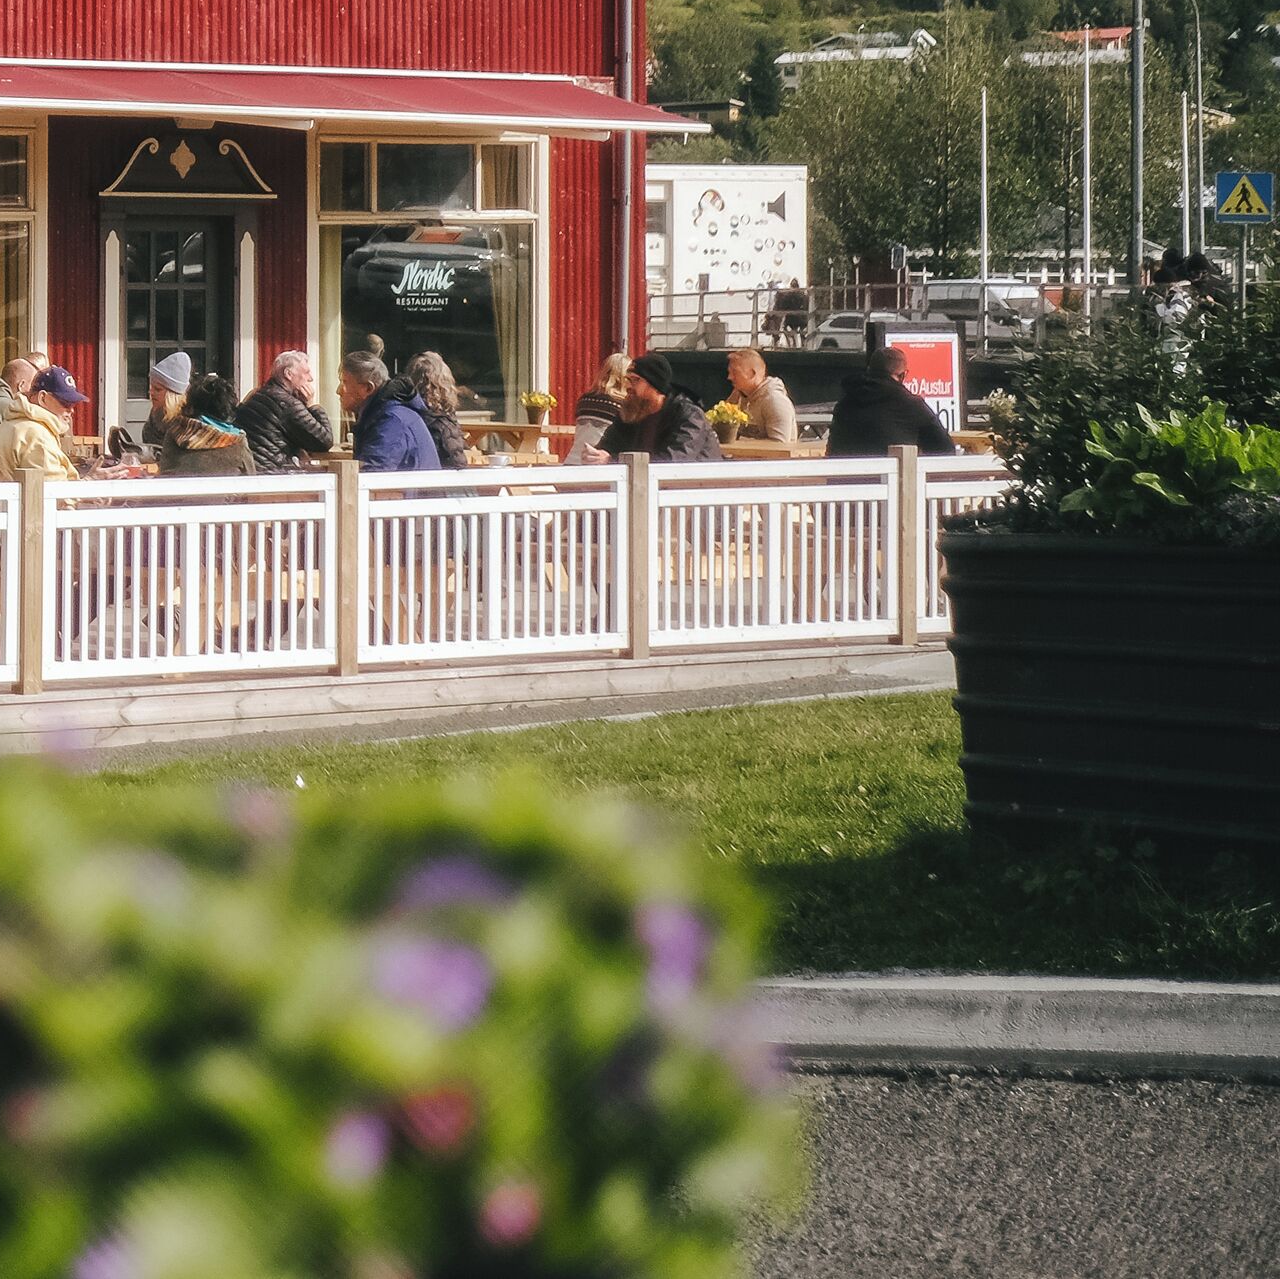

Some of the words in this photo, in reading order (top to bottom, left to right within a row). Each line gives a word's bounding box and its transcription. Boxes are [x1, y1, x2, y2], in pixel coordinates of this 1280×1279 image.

[390, 259, 456, 294] Nordic
[395, 297, 449, 306] RESTAURANT
[919, 377, 953, 395] Austur
